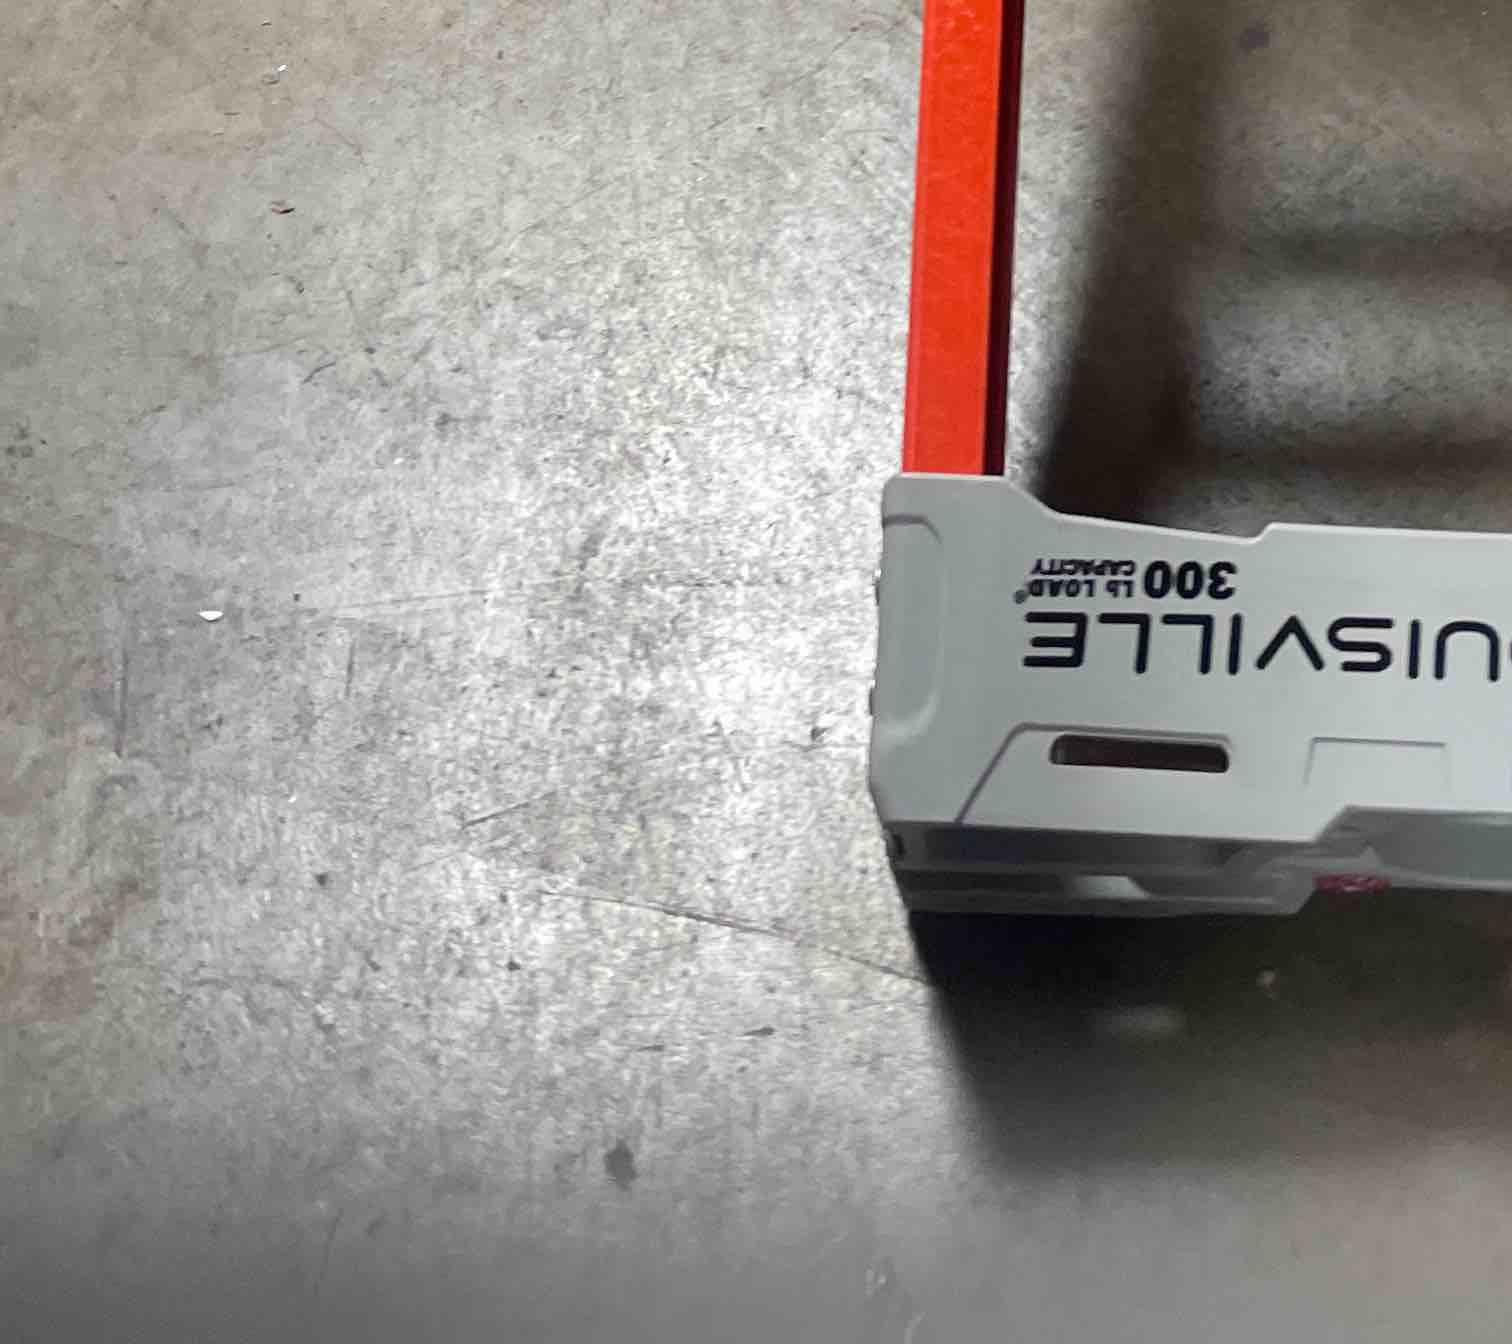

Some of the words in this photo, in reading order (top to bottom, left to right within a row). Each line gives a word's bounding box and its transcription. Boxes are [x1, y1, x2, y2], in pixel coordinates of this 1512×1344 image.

[1031, 558, 1137, 577] CAPACITY
[1027, 578, 1097, 598] LOAD
[1142, 560, 1238, 600] 300
